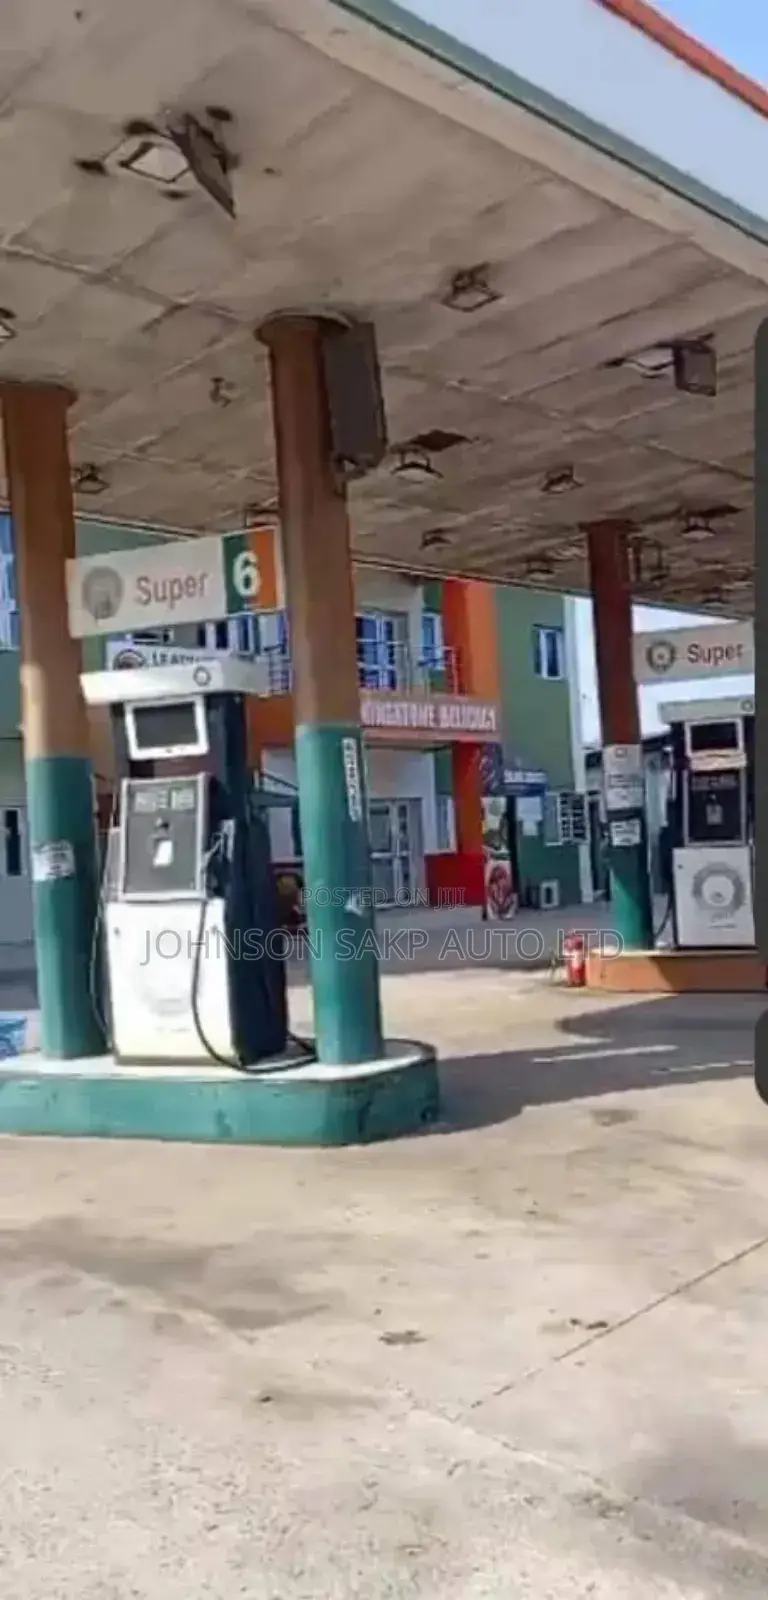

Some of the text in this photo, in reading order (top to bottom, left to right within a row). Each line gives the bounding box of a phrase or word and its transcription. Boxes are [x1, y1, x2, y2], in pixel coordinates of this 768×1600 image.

[135, 550, 262, 610] Super 6
[686, 642, 744, 666] Super
